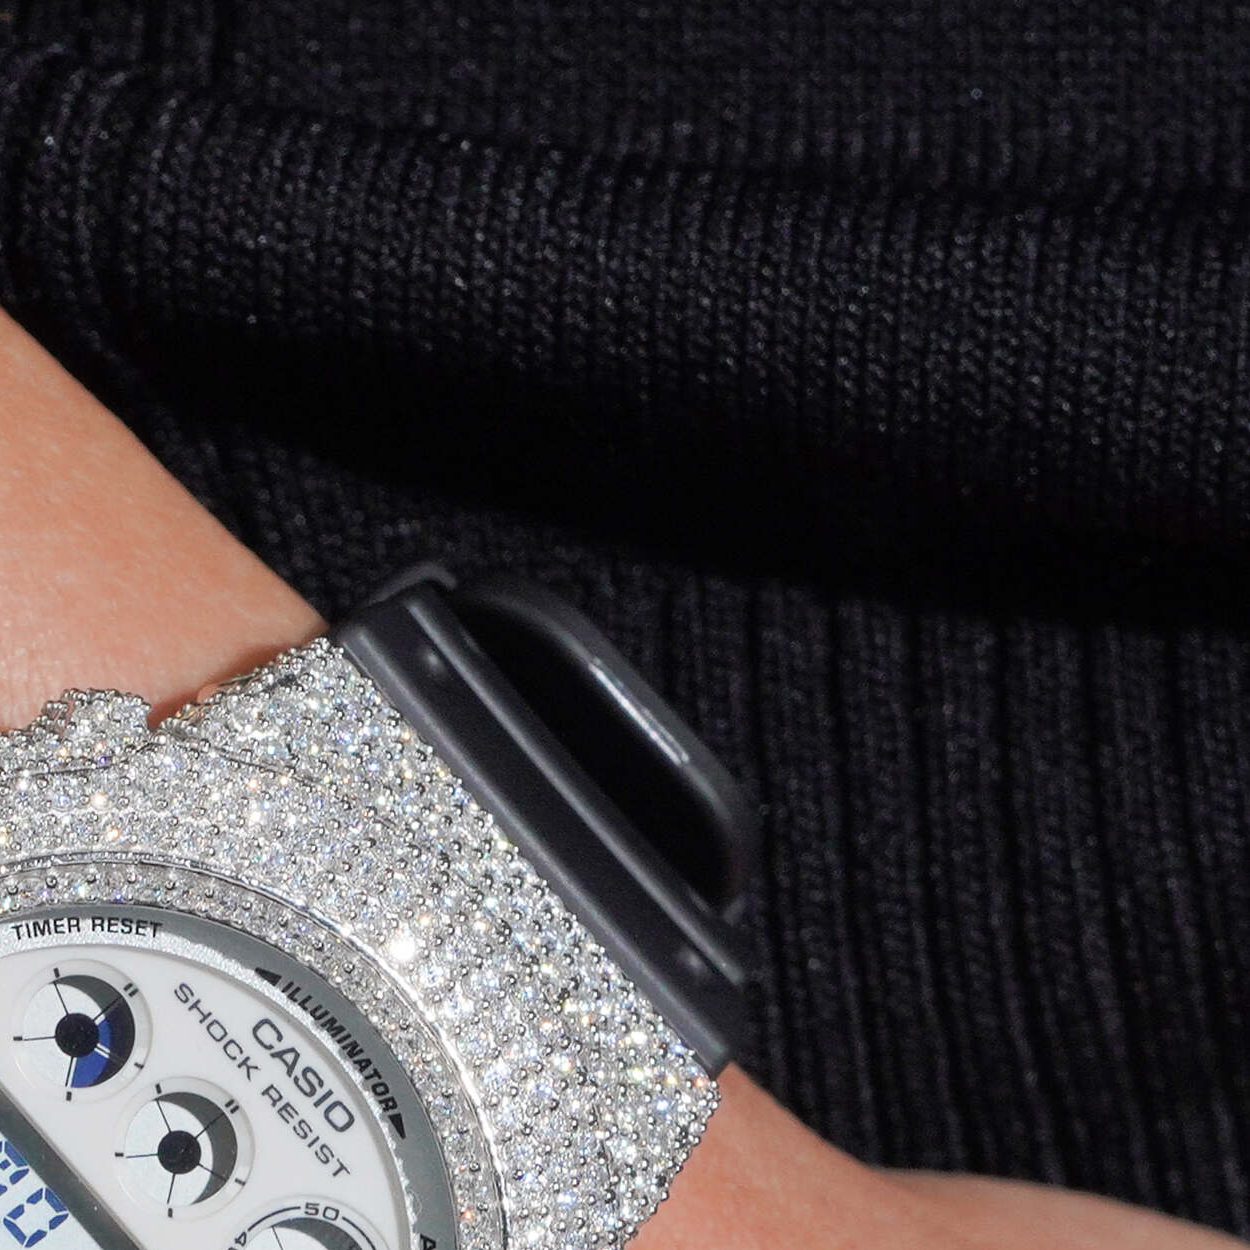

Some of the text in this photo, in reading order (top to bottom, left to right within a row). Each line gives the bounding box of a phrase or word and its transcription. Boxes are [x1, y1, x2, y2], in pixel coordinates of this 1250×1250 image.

[11, 916, 163, 940] TIMER RESET
[173, 982, 351, 1178] SHOCK RESIST
[251, 1017, 356, 1133] CASIO
[281, 980, 399, 1113] ILLUMINATOR
[303, 1202, 340, 1222] 50
